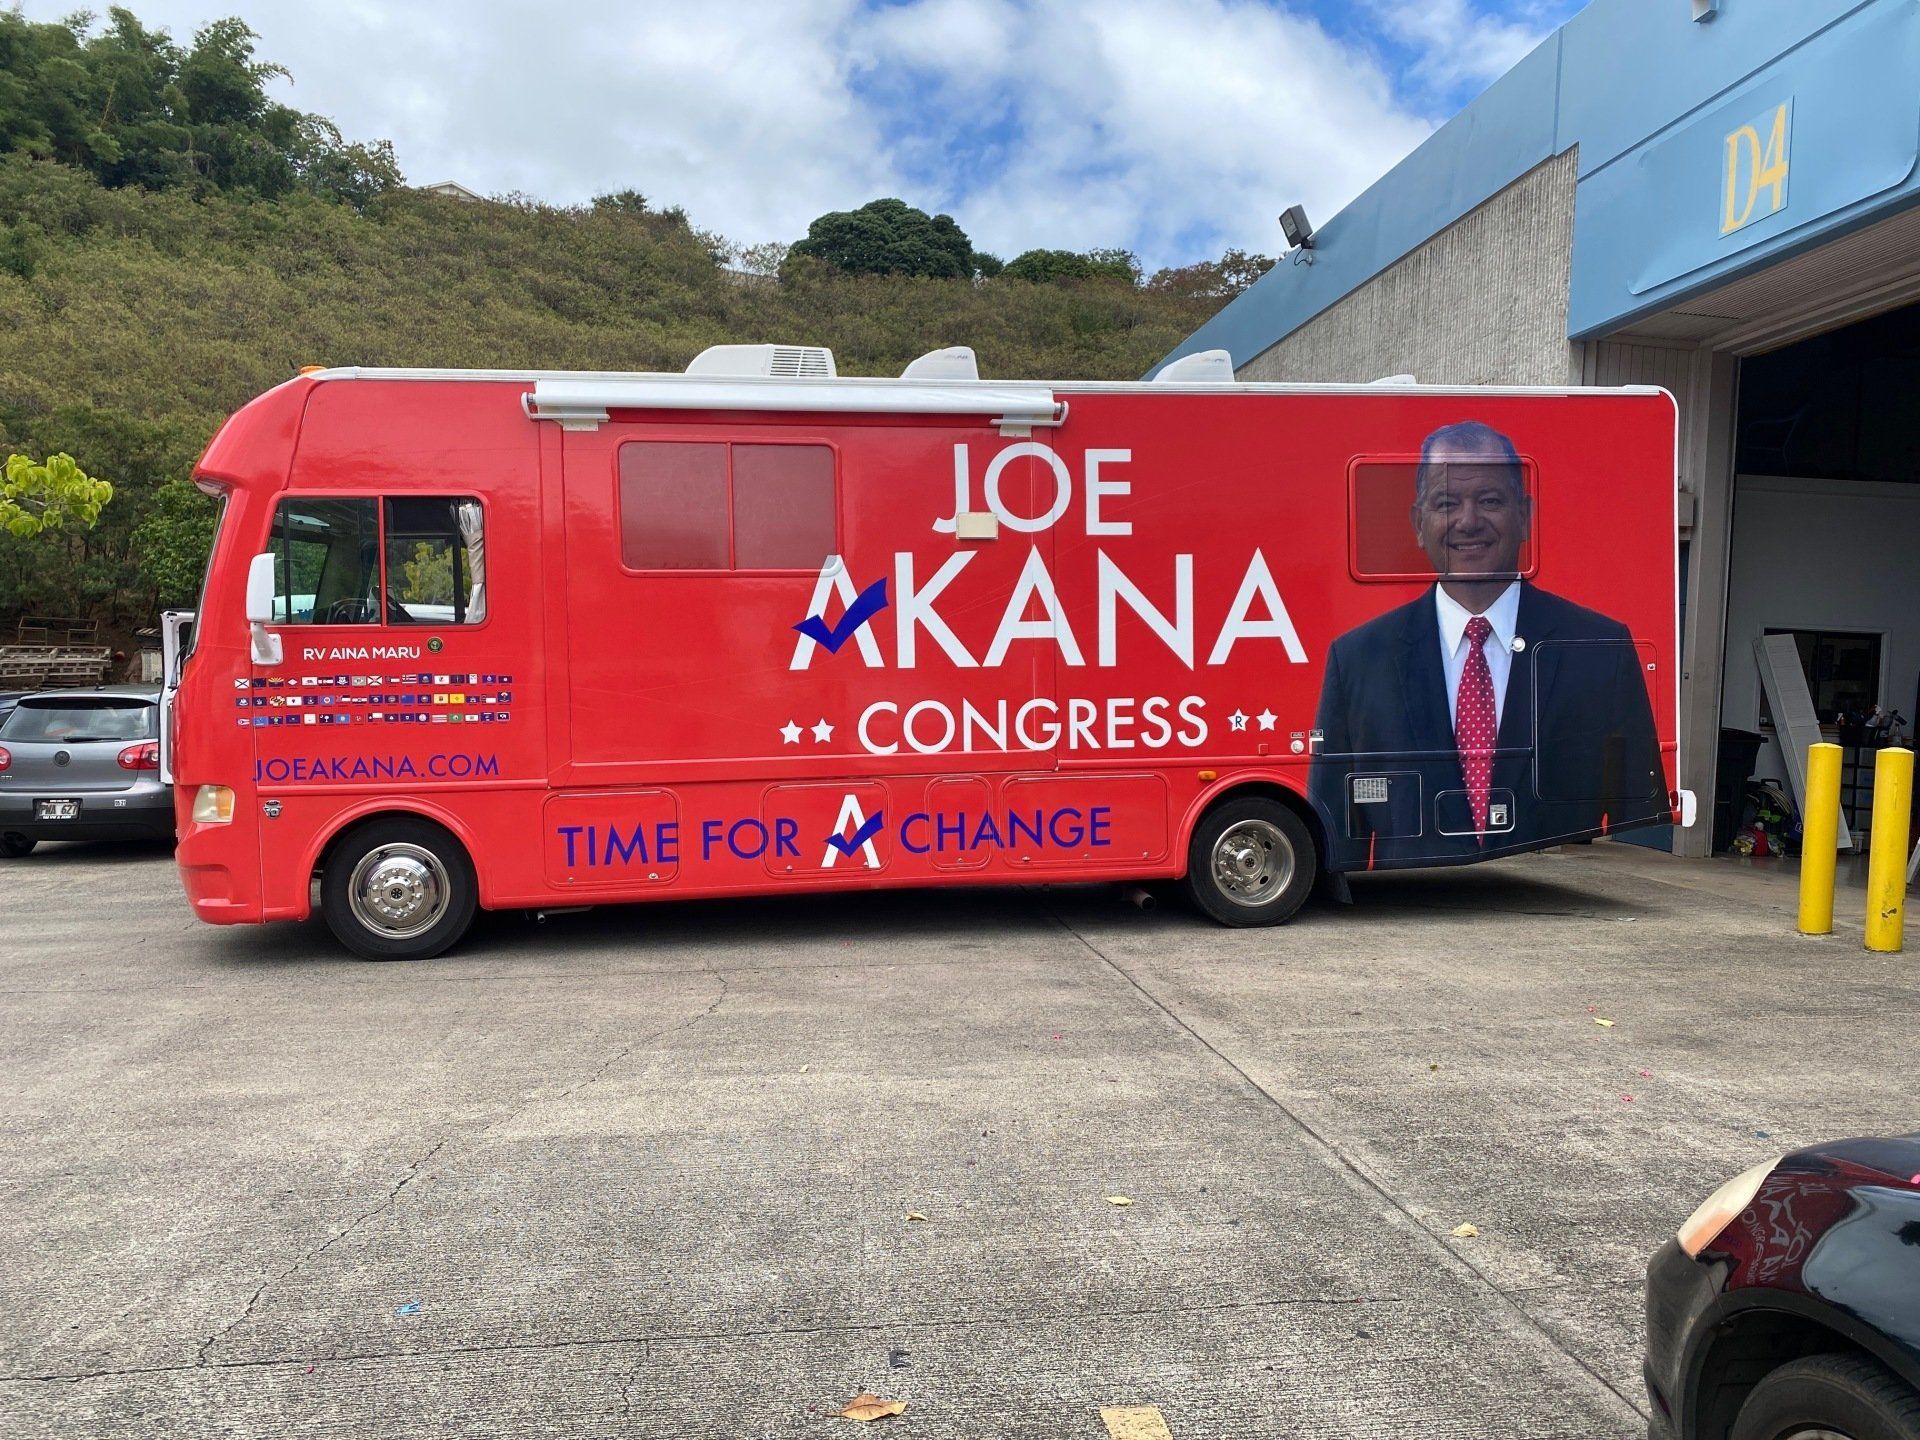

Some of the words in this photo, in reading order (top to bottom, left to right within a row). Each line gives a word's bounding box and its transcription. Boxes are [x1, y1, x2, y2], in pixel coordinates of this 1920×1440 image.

[1722, 104, 1787, 233] D4
[932, 442, 1133, 535] JOE
[789, 543, 1309, 671] AKANA
[303, 648, 326, 661] RV
[329, 647, 370, 660] AINA
[373, 646, 420, 660] MARU
[857, 695, 1208, 756] CONGRESS
[1234, 715, 1243, 728] R
[253, 754, 499, 782] JOEAKANA.COM
[557, 822, 679, 867] TIME
[702, 818, 800, 861] FOR
[820, 794, 882, 869] A
[899, 806, 1111, 854] CHANGE
